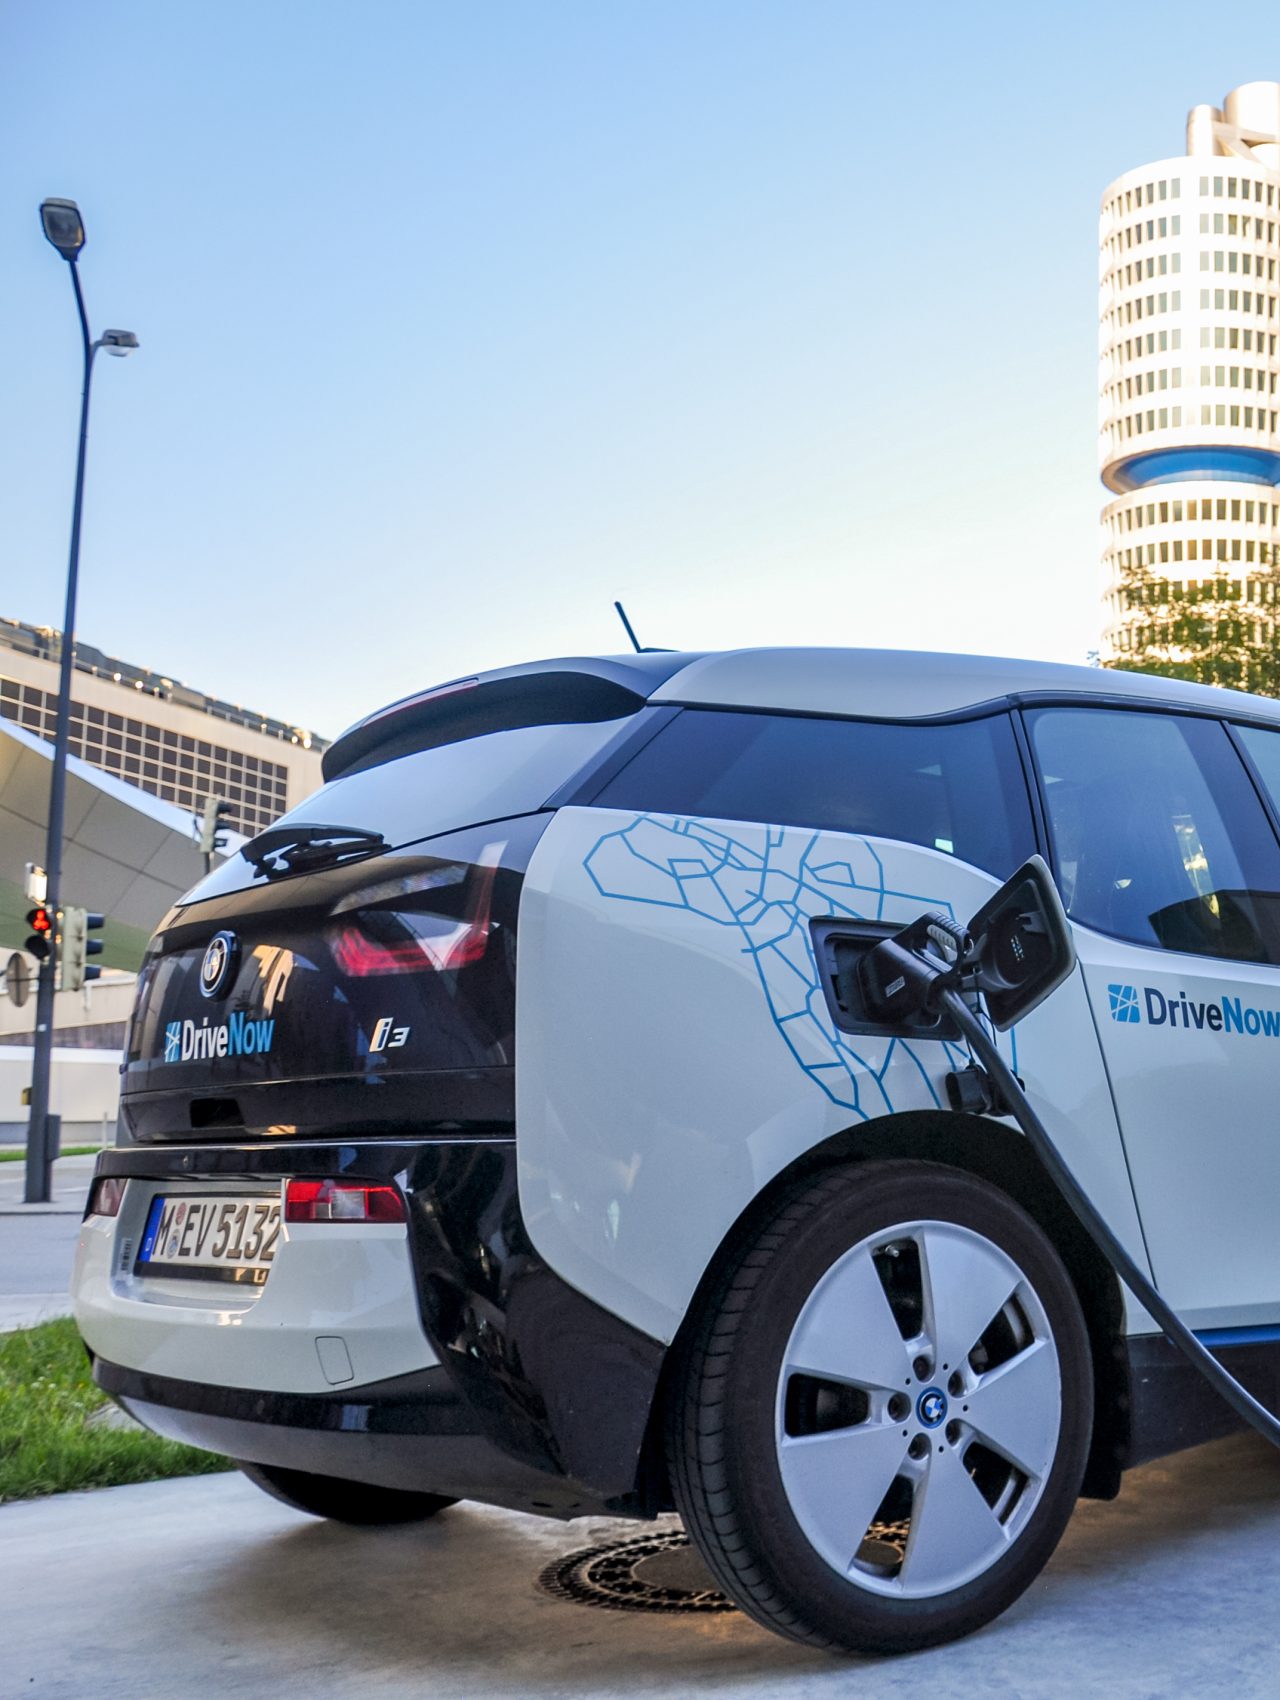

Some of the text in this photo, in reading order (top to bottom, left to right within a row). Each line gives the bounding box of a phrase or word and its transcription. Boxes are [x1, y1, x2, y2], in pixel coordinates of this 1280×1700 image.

[181, 1011, 275, 1061] DriveNow
[1143, 987, 1280, 1037] DriveNow
[178, 1204, 217, 1257] EV
[211, 1204, 280, 1261] 5132
